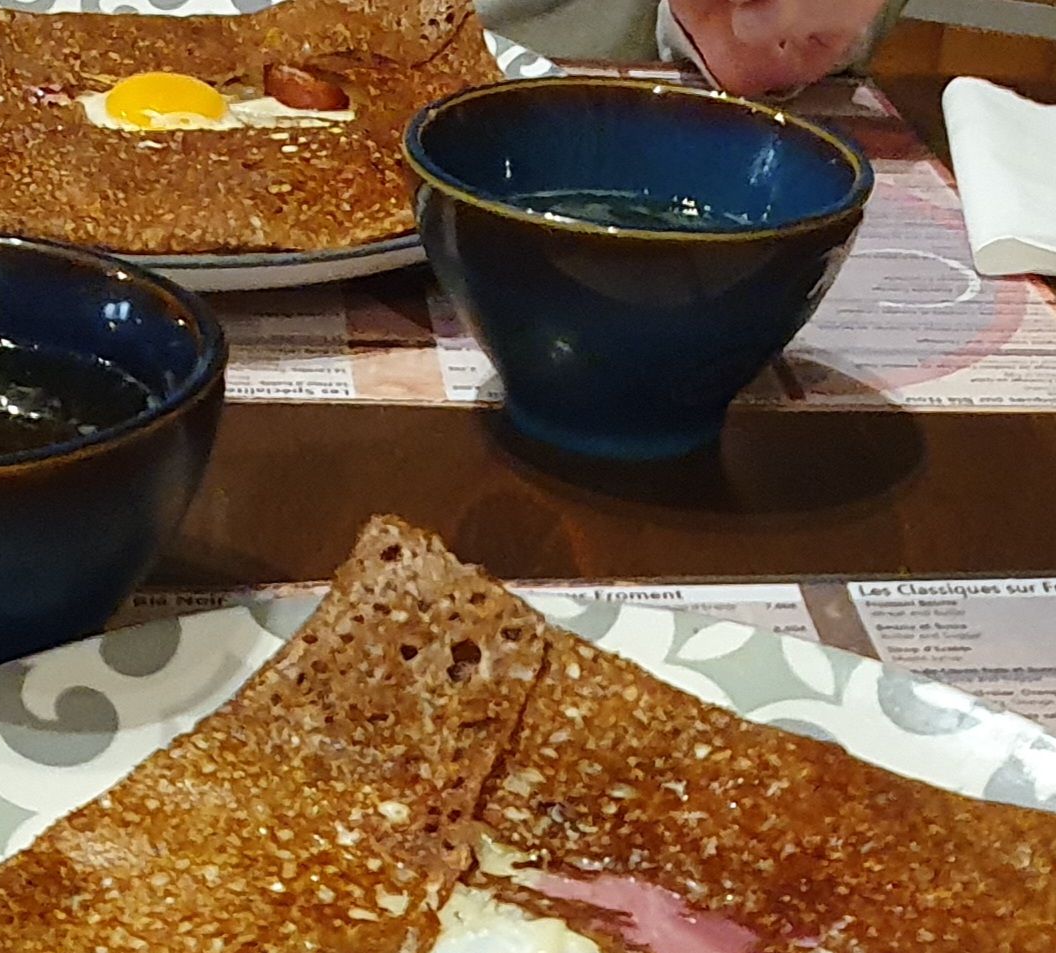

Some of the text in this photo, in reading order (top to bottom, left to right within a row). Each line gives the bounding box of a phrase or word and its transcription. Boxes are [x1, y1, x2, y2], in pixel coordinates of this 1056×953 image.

[594, 589, 684, 602] Froment
[859, 584, 891, 597] Les
[897, 583, 1001, 599] Classiques
[1006, 584, 1036, 595] sur
